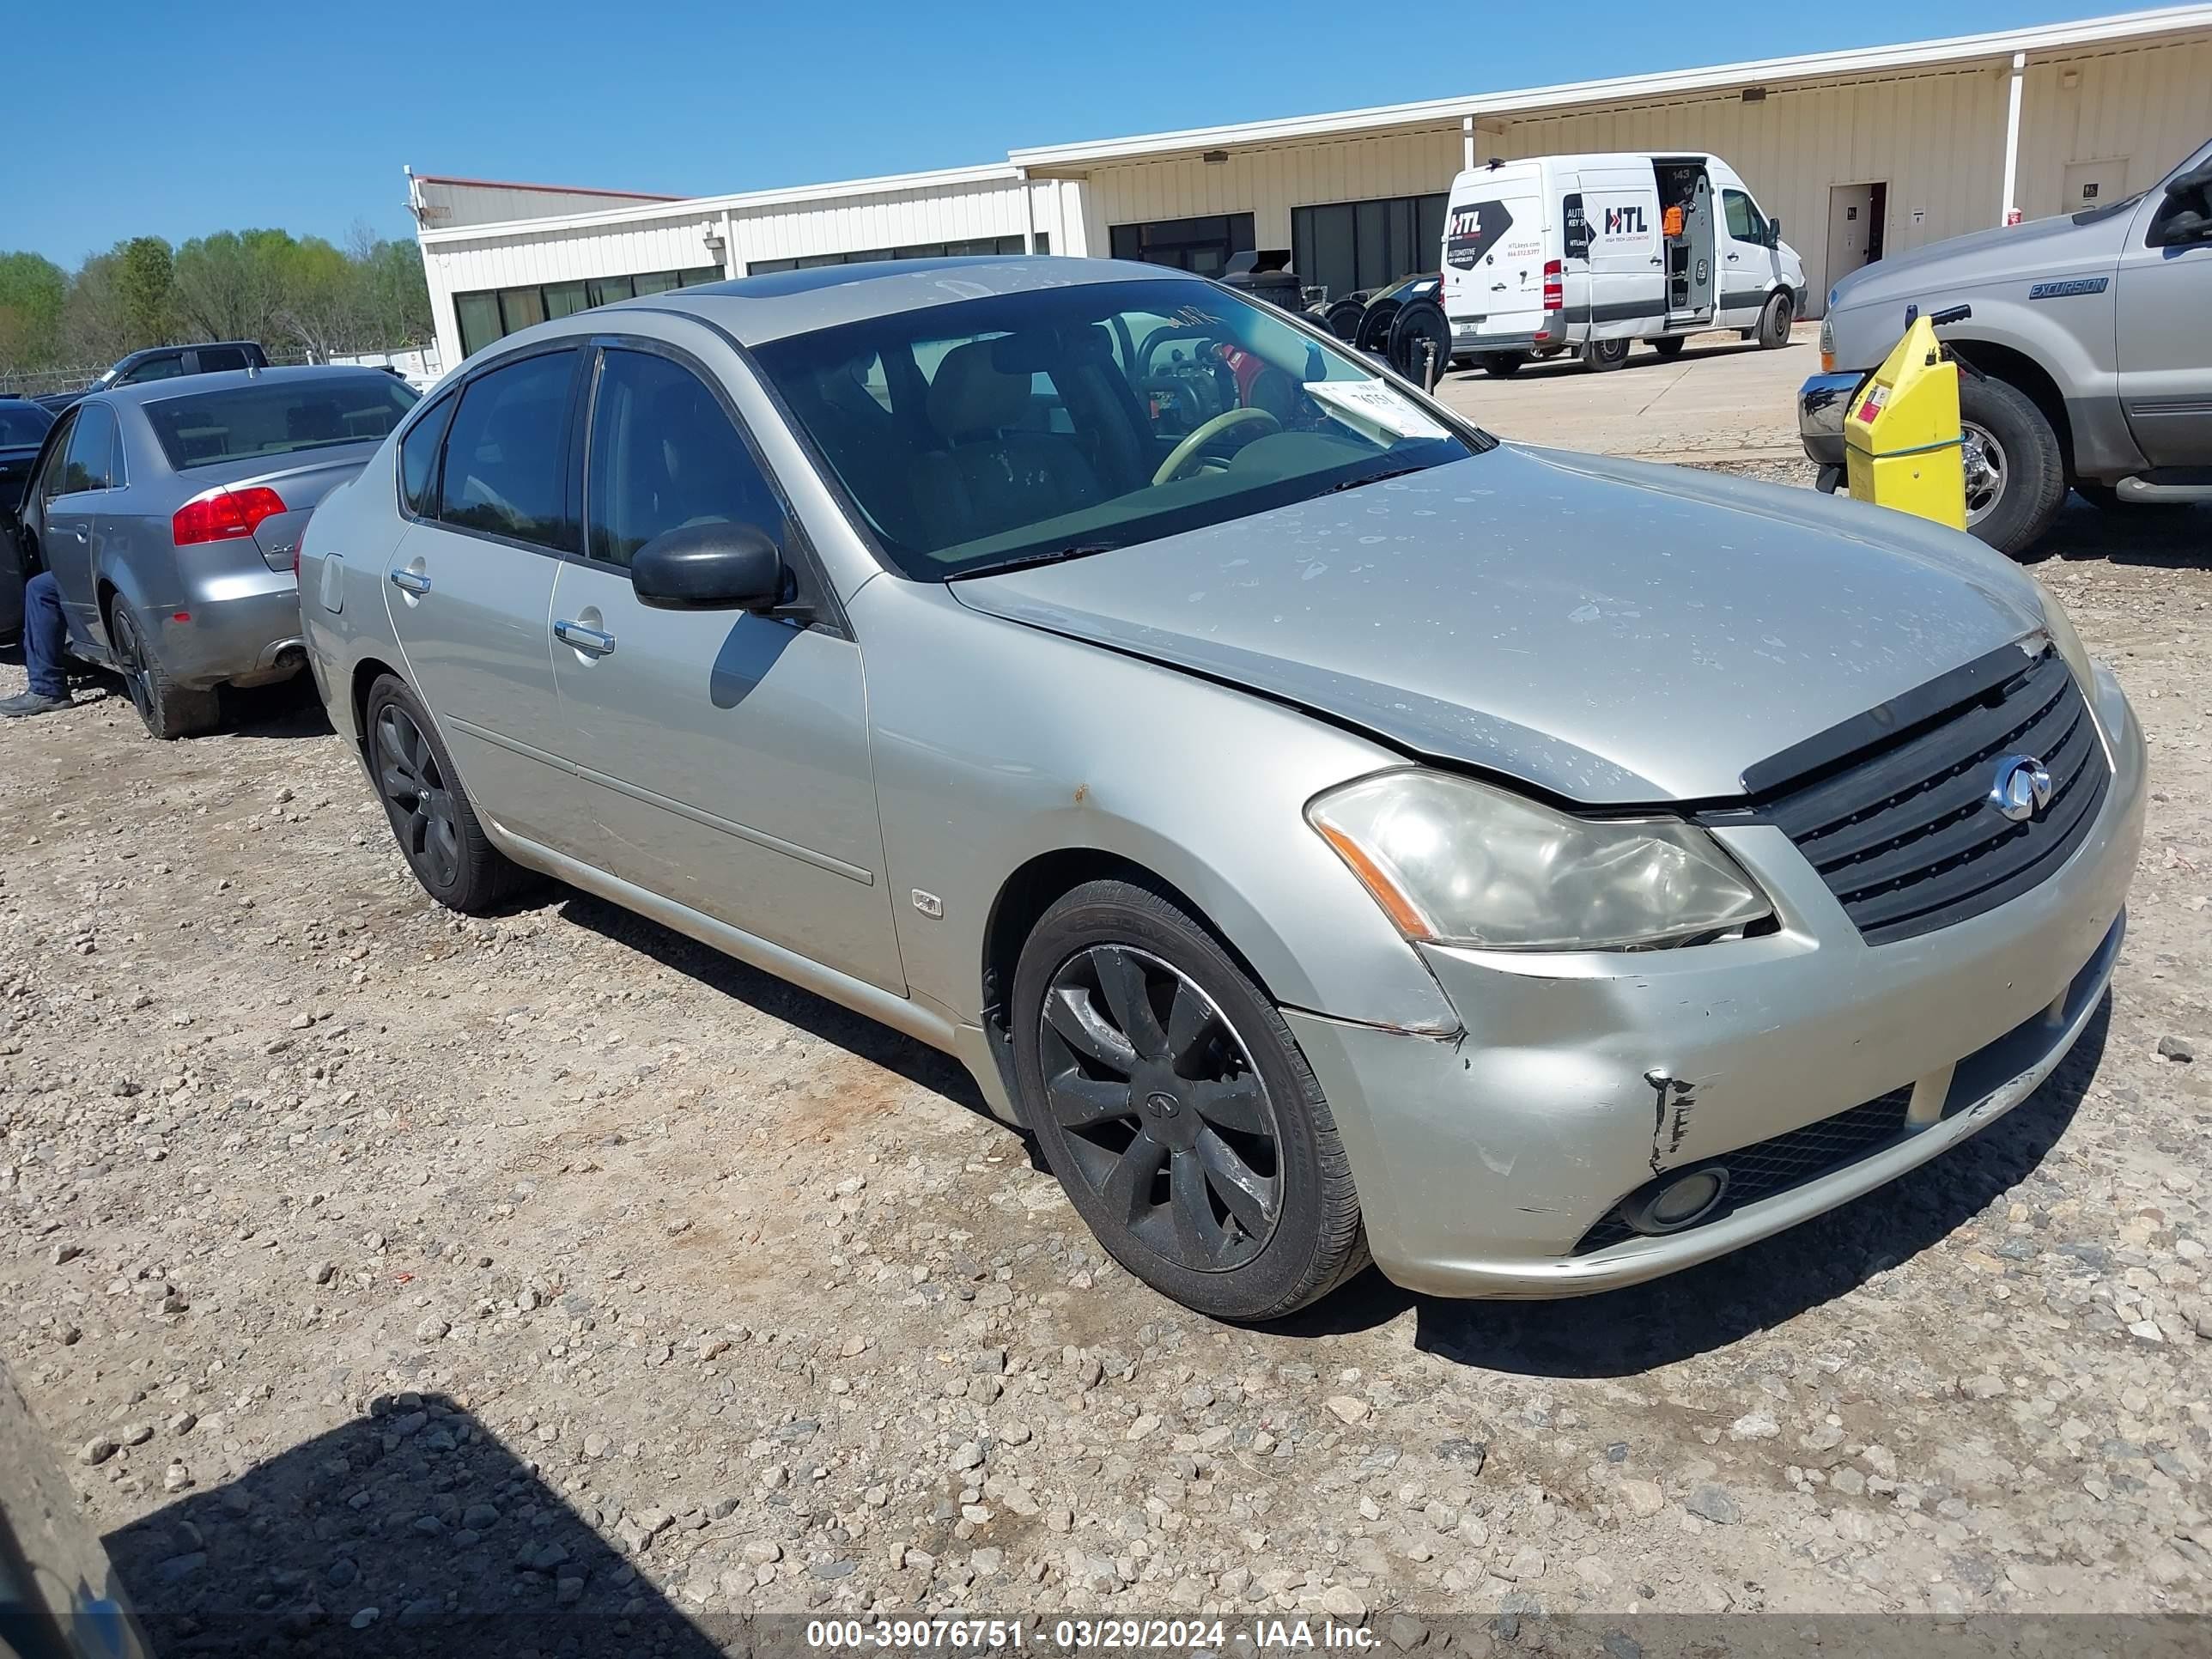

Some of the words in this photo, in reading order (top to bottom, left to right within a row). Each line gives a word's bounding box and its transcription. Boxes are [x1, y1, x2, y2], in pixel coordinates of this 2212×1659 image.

[1449, 210, 1481, 235] HTL
[1605, 206, 1648, 234] HTL
[1449, 247, 1477, 258] AUTOMOTIVE
[2031, 279, 2107, 297] EXCURSION
